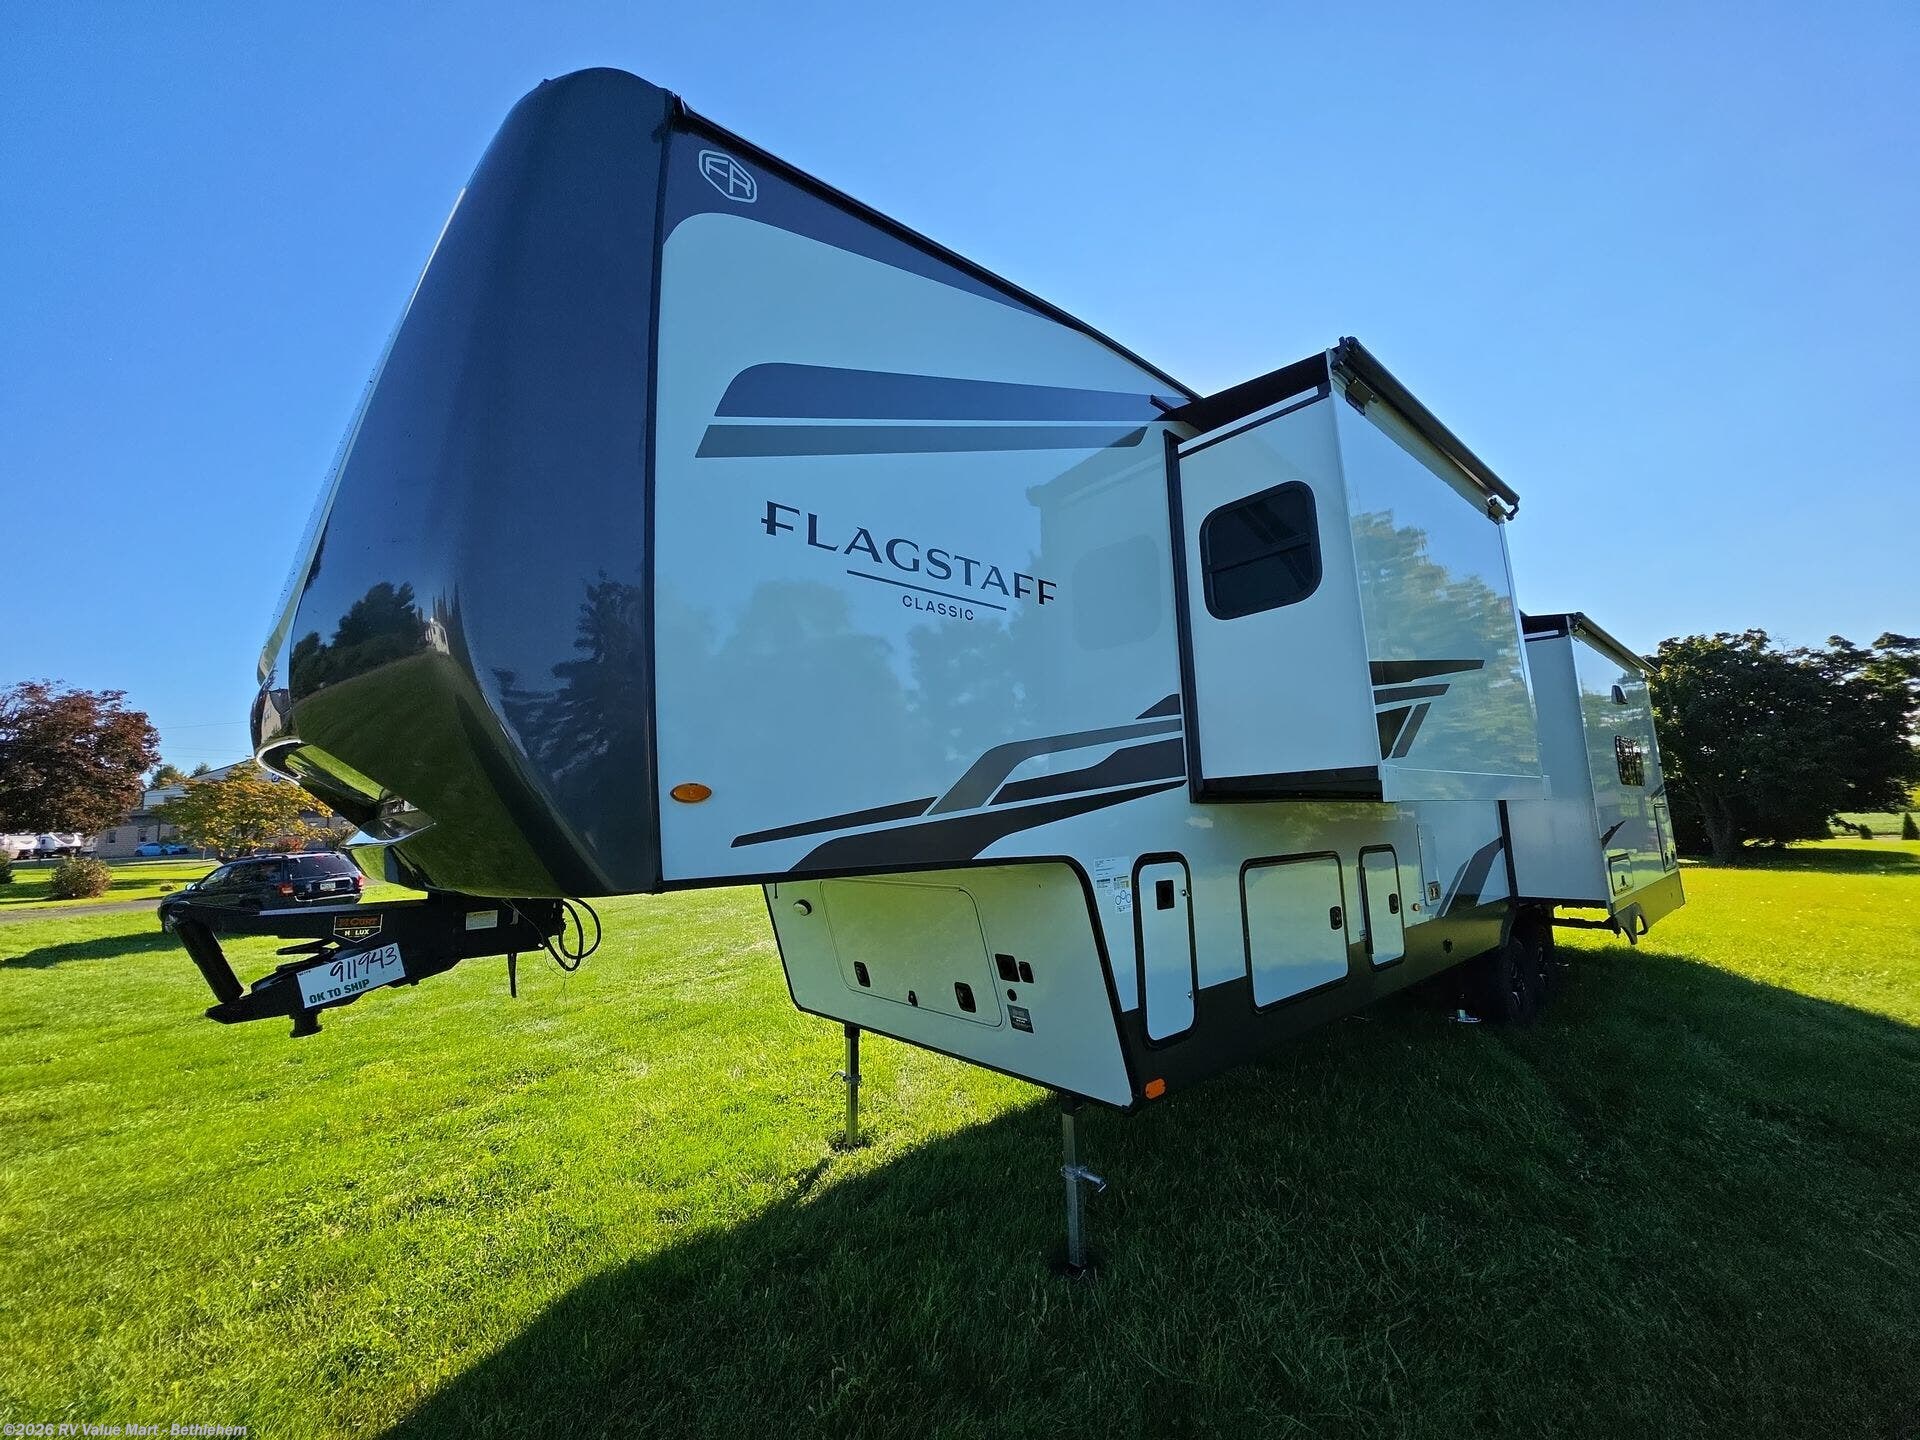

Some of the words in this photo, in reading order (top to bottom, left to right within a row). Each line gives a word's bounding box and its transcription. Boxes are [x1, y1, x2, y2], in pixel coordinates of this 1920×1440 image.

[761, 500, 1057, 605] FLAGSTAFF
[902, 595, 974, 621] CLASSIC
[330, 947, 397, 983] 911943
[309, 992, 327, 1004] OK
[327, 987, 341, 999] TO
[344, 978, 370, 994] SHIP
